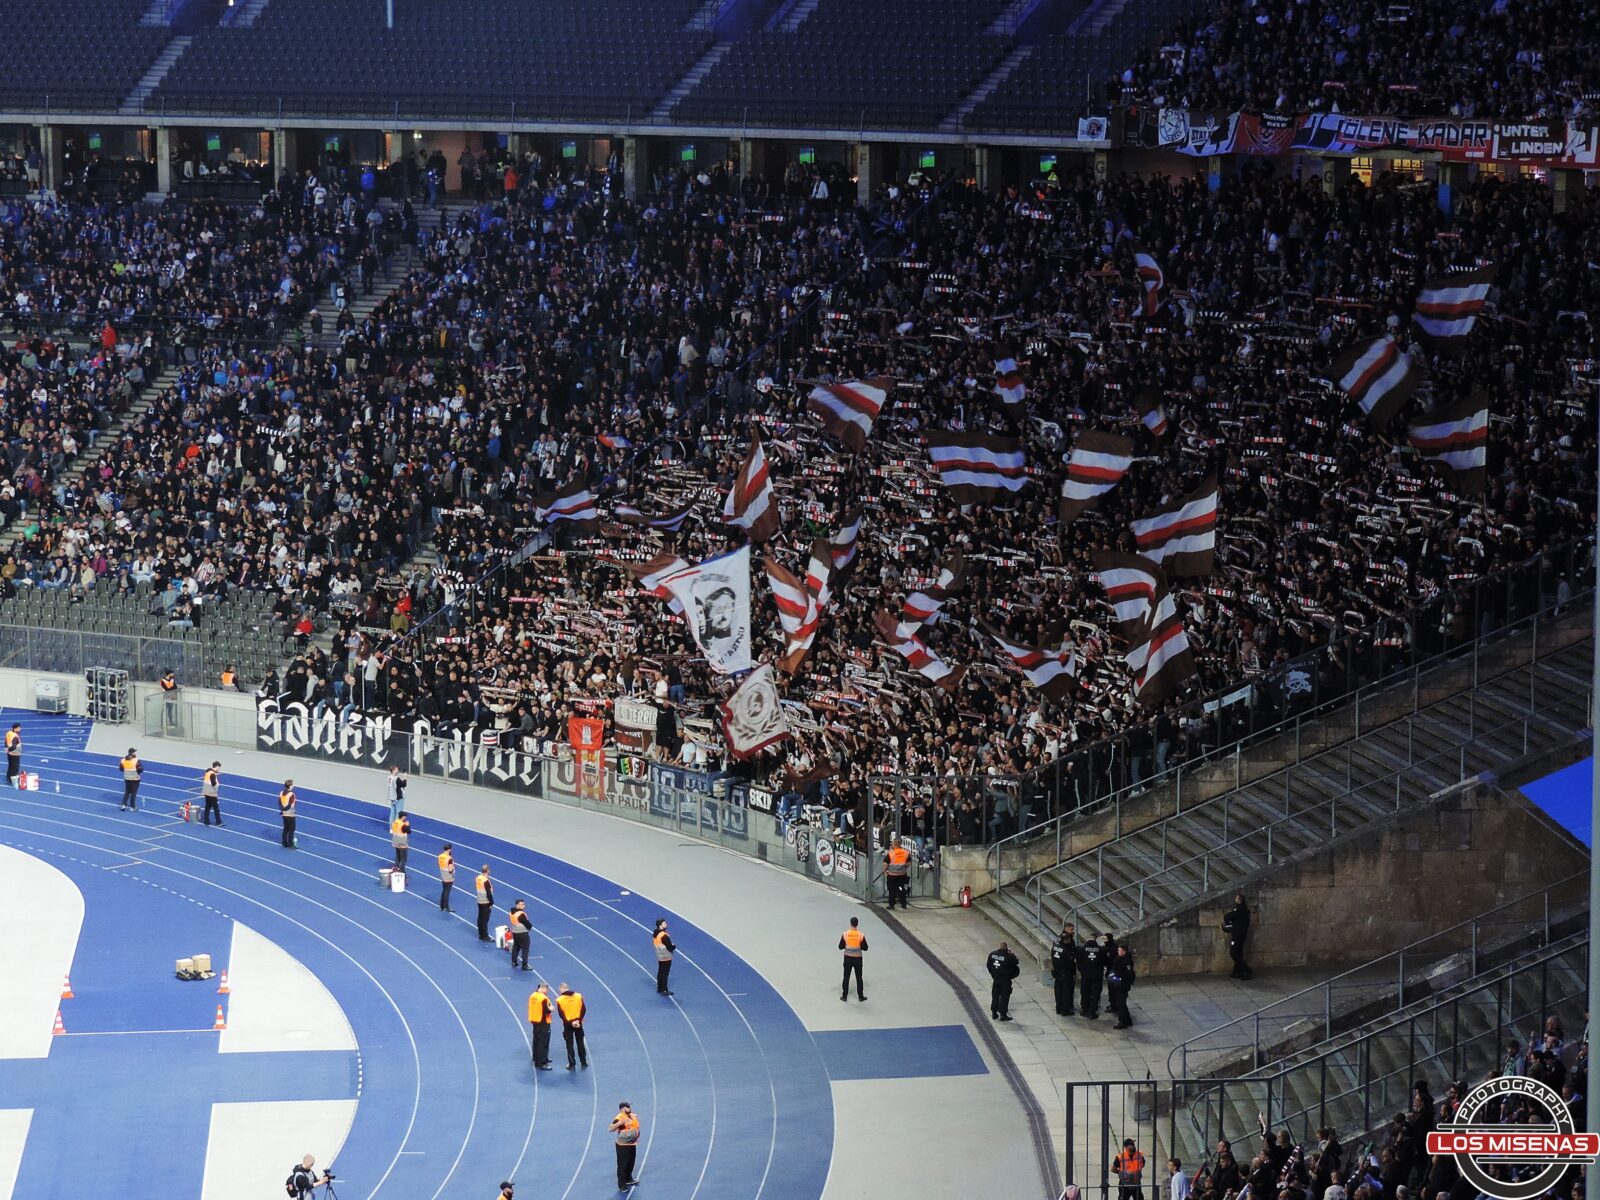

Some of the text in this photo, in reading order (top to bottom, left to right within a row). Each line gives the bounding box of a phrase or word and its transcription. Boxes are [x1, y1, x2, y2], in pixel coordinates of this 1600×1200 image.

[1417, 121, 1489, 148] KADAR
[1502, 125, 1549, 137] UNTER
[1511, 142, 1563, 154] LINDEN
